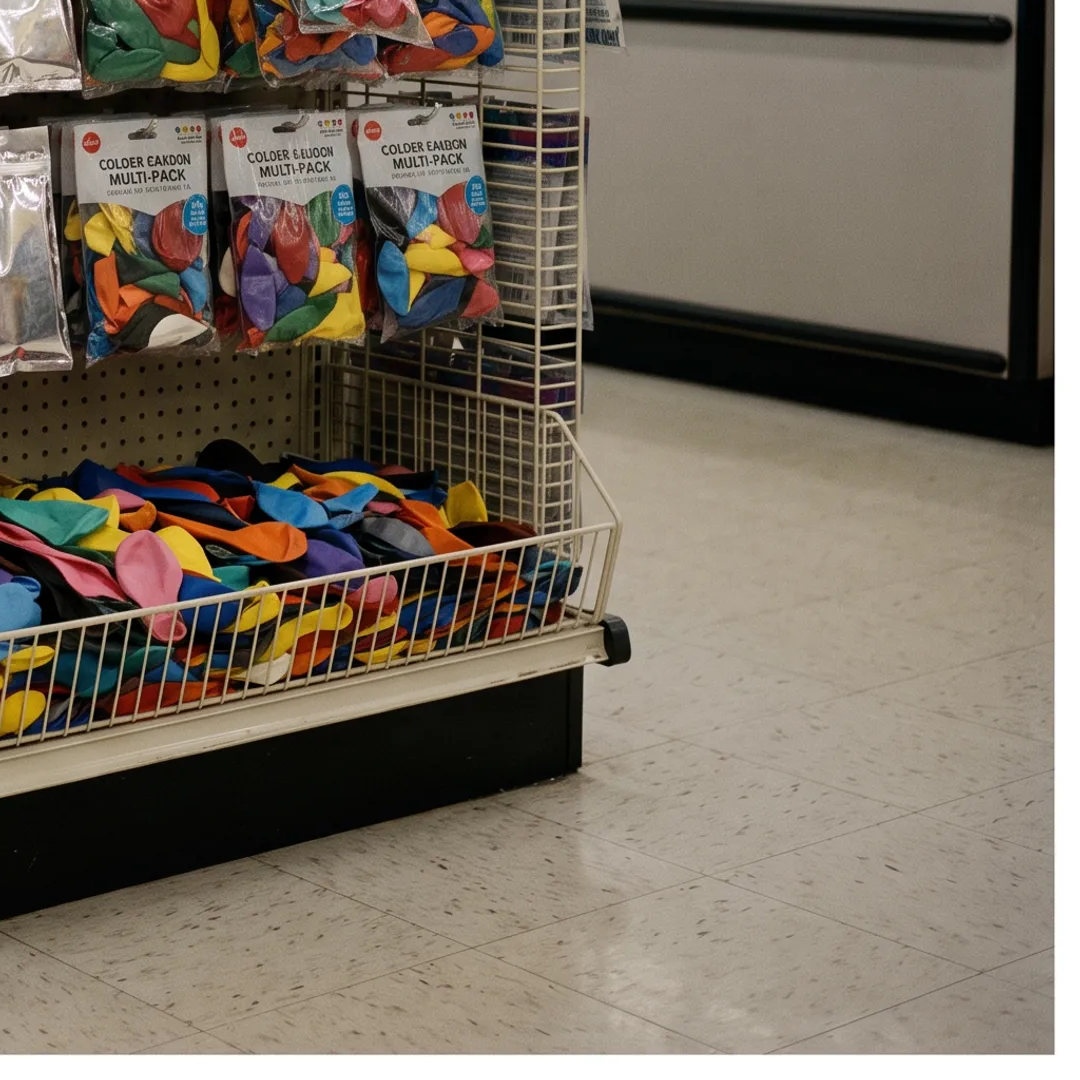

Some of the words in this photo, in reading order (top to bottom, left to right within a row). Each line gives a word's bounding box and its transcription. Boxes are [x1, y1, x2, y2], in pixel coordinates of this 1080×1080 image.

[259, 160, 332, 179] MULTI-PACK
[392, 152, 464, 170] MULTI-PACK
[109, 168, 187, 187] MULTI-PACK
